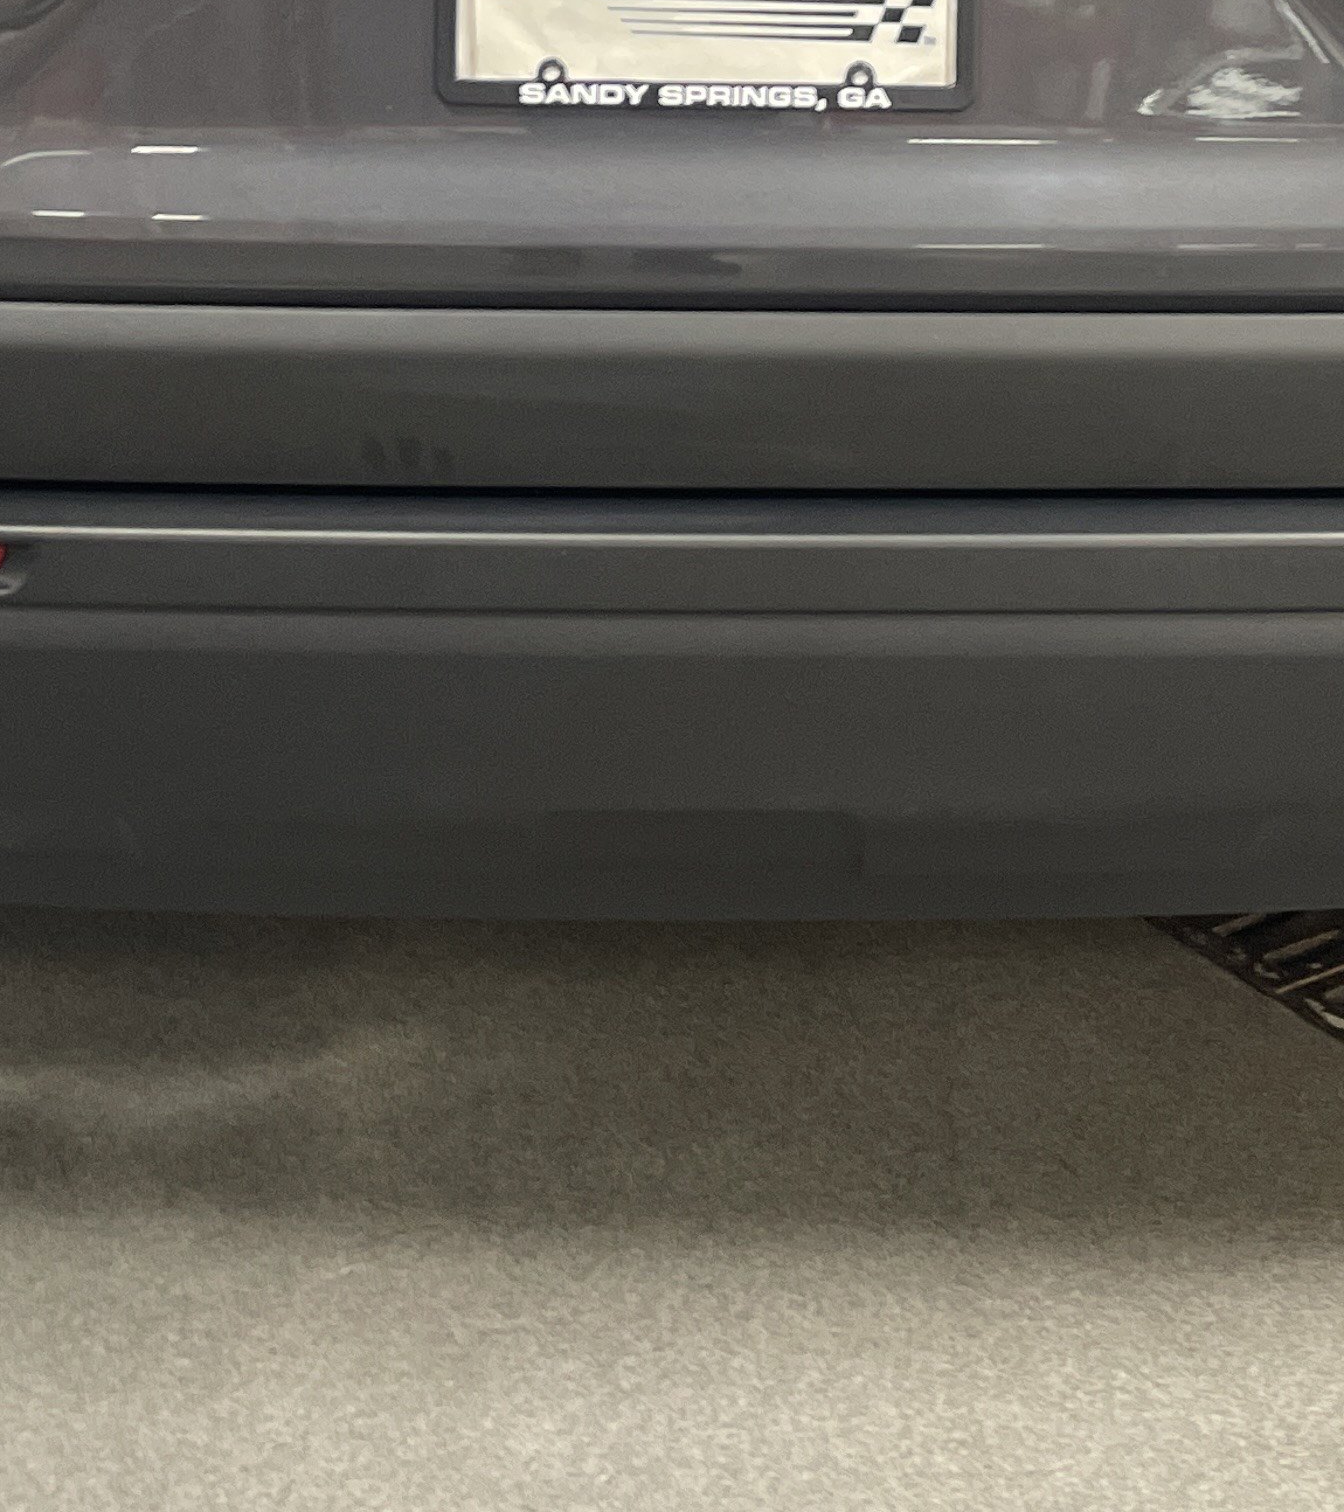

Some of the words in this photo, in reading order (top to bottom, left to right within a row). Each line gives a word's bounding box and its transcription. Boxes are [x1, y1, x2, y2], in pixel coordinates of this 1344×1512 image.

[519, 83, 654, 106] SANDY
[658, 85, 825, 111] SPRINGS,
[837, 87, 891, 109] GA
